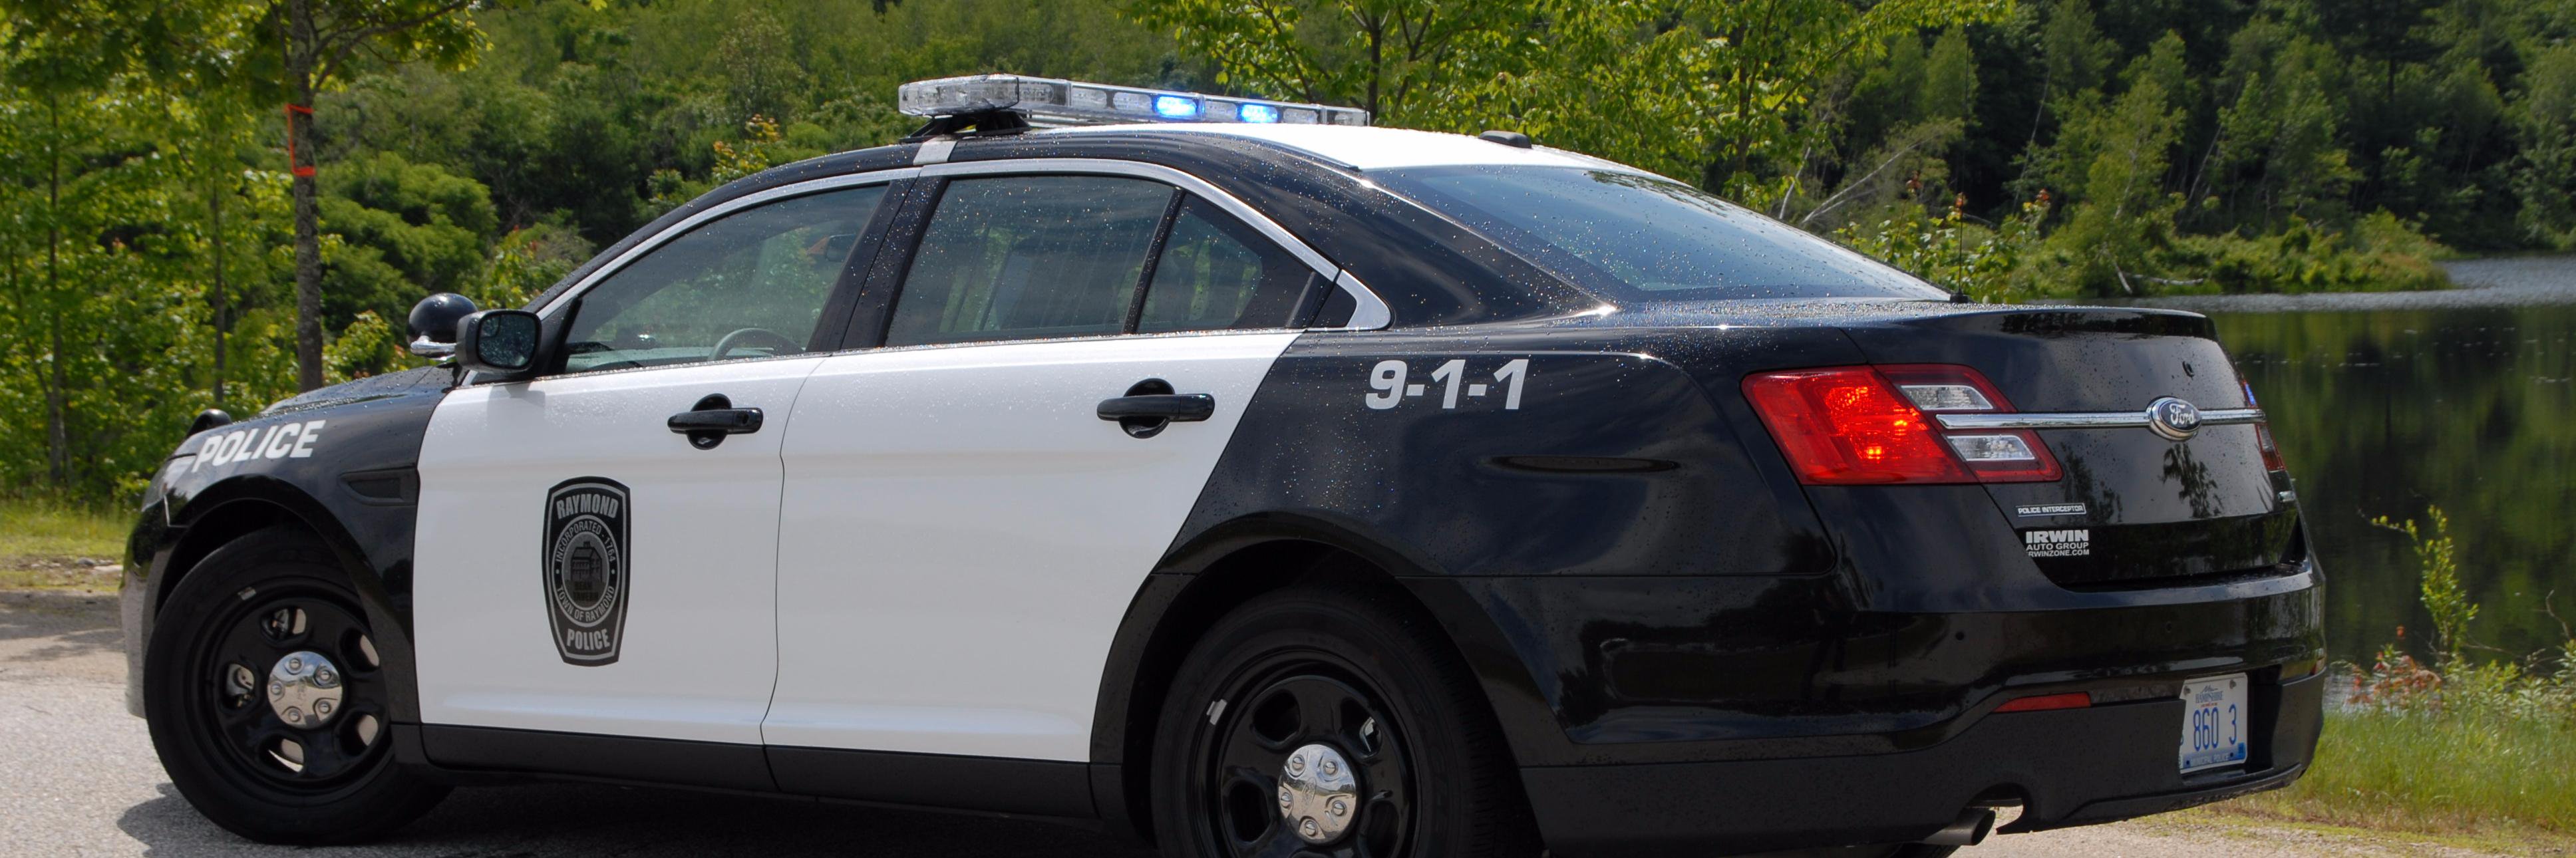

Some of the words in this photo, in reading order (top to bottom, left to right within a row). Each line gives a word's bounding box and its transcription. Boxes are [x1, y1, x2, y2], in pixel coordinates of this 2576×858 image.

[1365, 359, 1530, 410] 9-1-1
[2169, 403, 2195, 424] Ford
[191, 420, 327, 473] POLICE
[556, 494, 619, 519] RAYMOND
[556, 520, 602, 563] INCORPORATED
[604, 537, 617, 562] 1764
[2026, 529, 2089, 543] IRWIN
[557, 585, 574, 617] TOWN
[574, 610, 585, 621] OF
[585, 585, 615, 622] RAYMOND
[566, 628, 611, 650] POLICE
[2193, 706, 2219, 751] 860
[2229, 703, 2237, 745] 3
